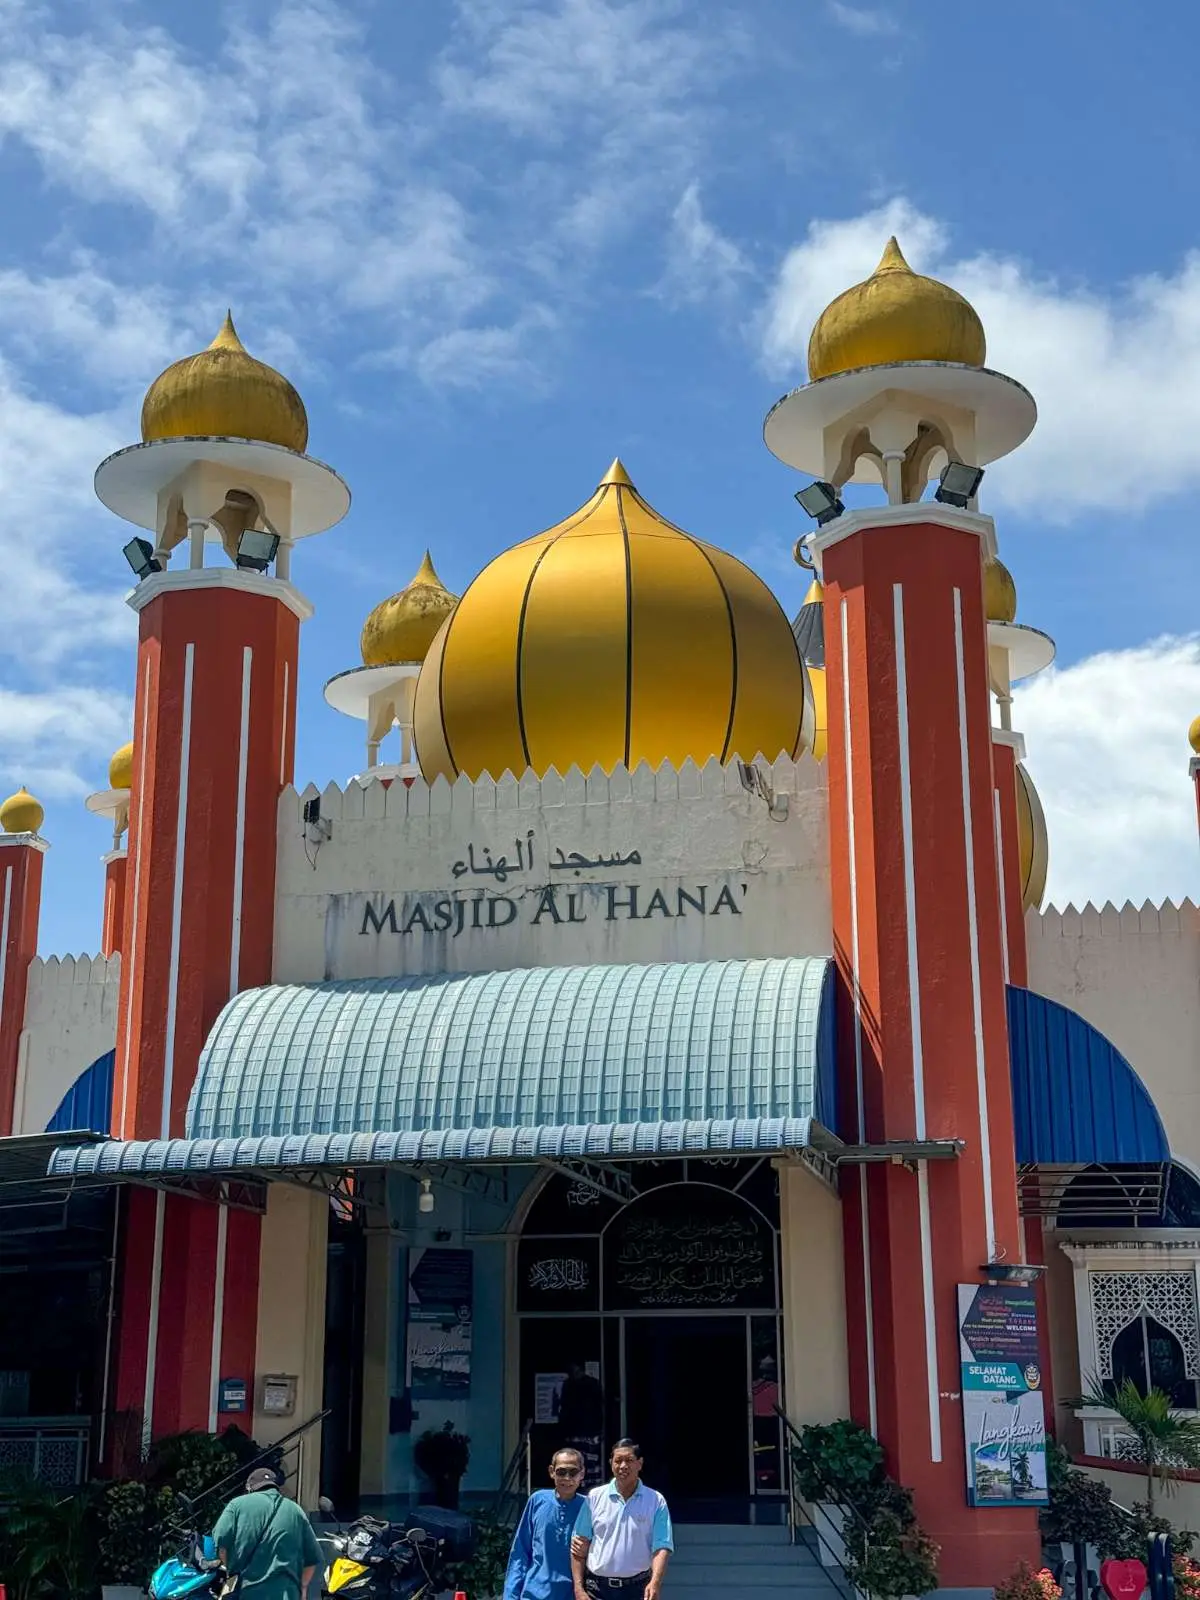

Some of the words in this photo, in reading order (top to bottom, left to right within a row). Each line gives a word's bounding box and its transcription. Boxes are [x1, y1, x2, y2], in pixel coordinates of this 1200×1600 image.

[549, 846, 642, 877] مسجد
[358, 896, 519, 938] MASJID
[530, 884, 588, 926] AL
[604, 883, 748, 922] HANA'
[969, 1366, 1007, 1375] SELAMAT
[983, 1375, 1017, 1384] DATANG
[974, 1404, 1042, 1461] Langkawi
